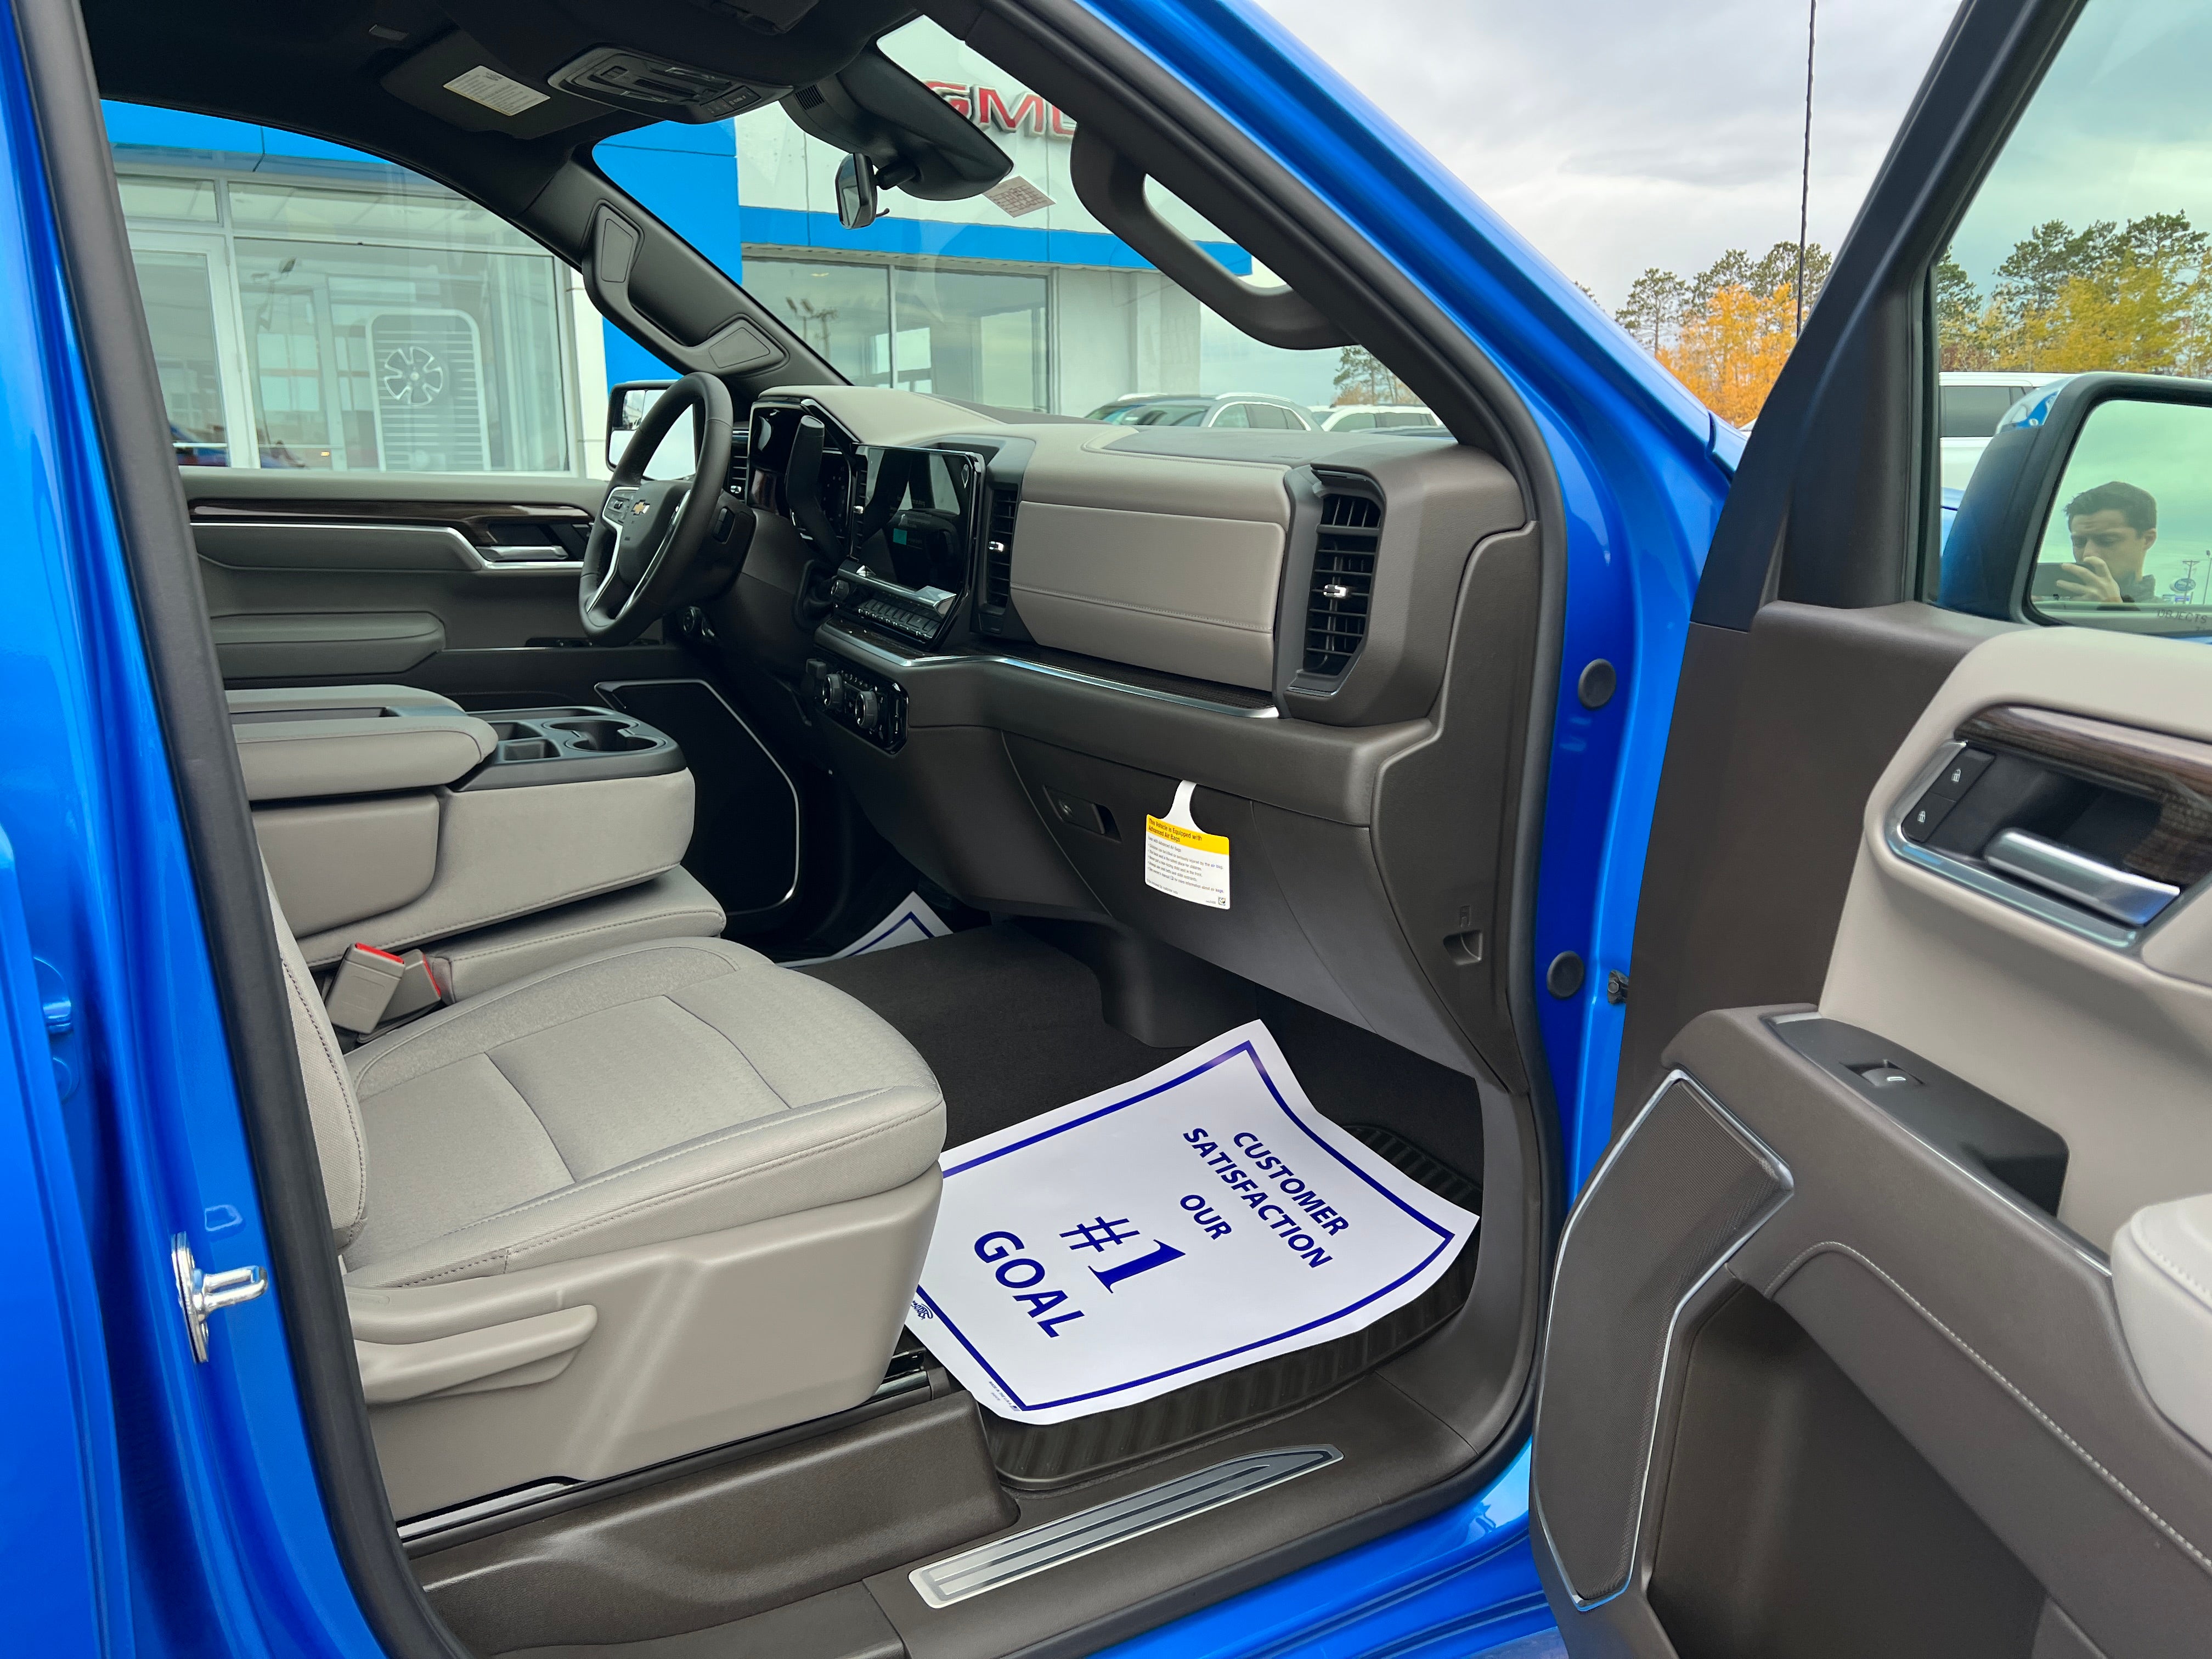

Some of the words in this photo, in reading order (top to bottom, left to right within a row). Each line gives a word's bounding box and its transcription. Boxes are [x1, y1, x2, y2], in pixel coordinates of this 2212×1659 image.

[2157, 609, 2208, 624] OBJECTS
[1149, 825, 1164, 836] Advanced
[1171, 834, 1180, 843] Bags
[1156, 821, 1167, 831] Vehicle
[1173, 828, 1191, 838] Equipped
[1183, 1128, 1333, 1268] SATISFACTION
[1234, 1132, 1349, 1235] CUSTOMER
[1180, 1194, 1232, 1240] OUR
[974, 1231, 1085, 1338] GOAL
[1060, 1216, 1186, 1293] #1
